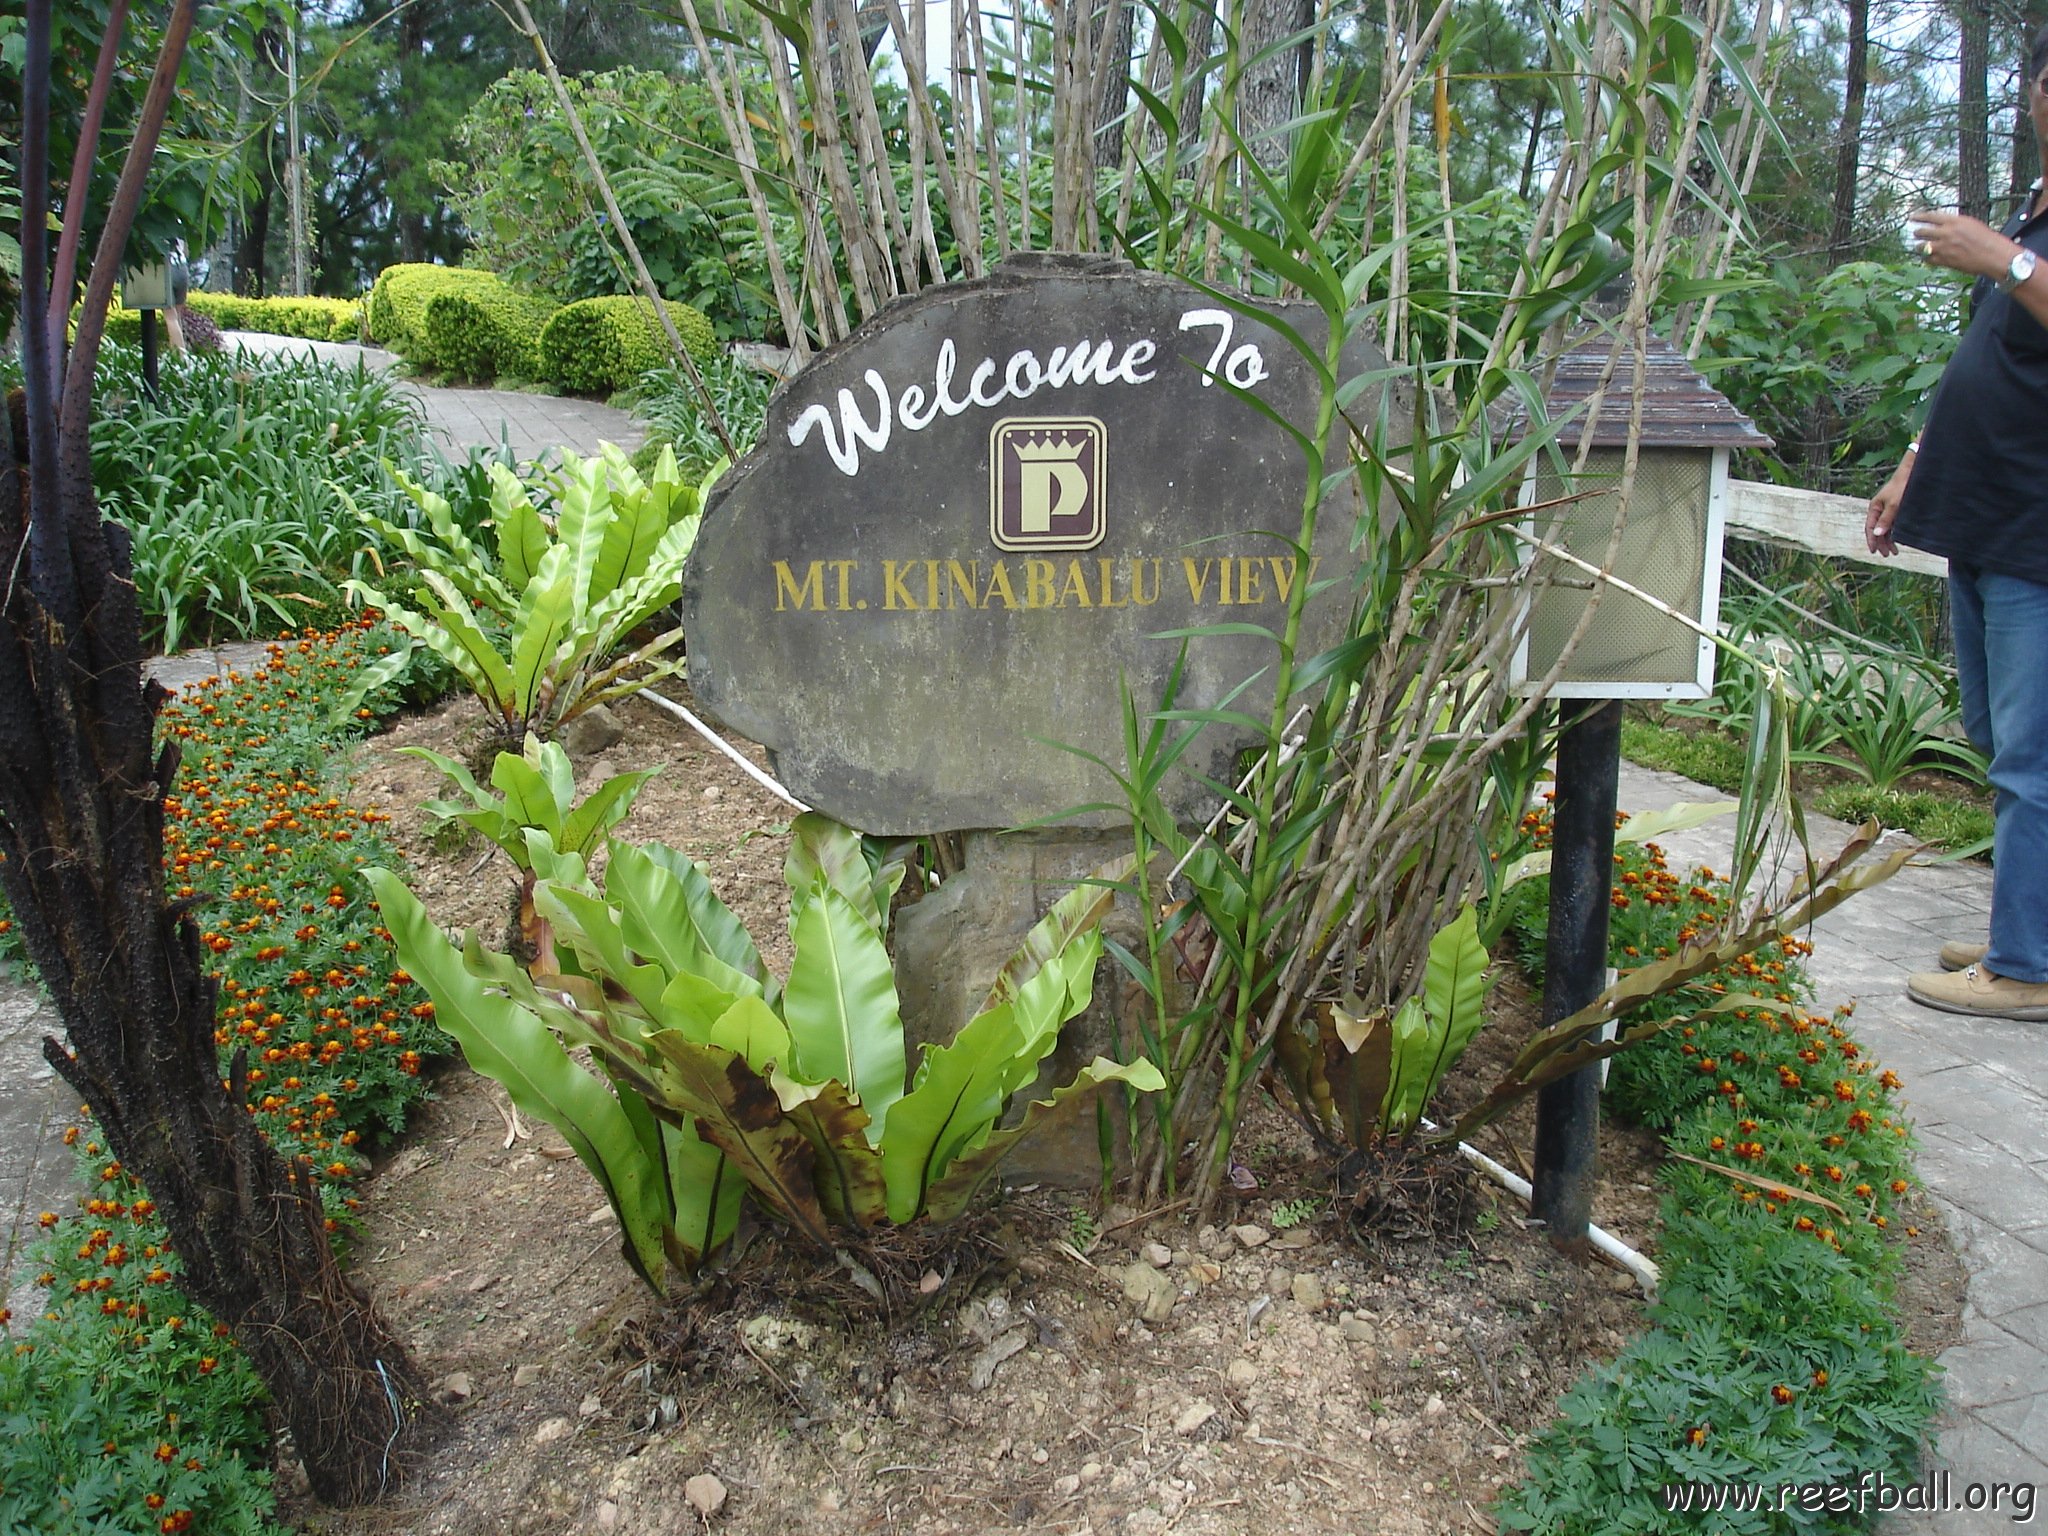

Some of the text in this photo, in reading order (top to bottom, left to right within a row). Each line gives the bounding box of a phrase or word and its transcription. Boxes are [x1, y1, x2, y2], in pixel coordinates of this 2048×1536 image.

[789, 308, 1270, 476] Welcome To
[1019, 462, 1088, 532] P
[773, 560, 867, 612] MT.
[881, 558, 1162, 611] KINABALU
